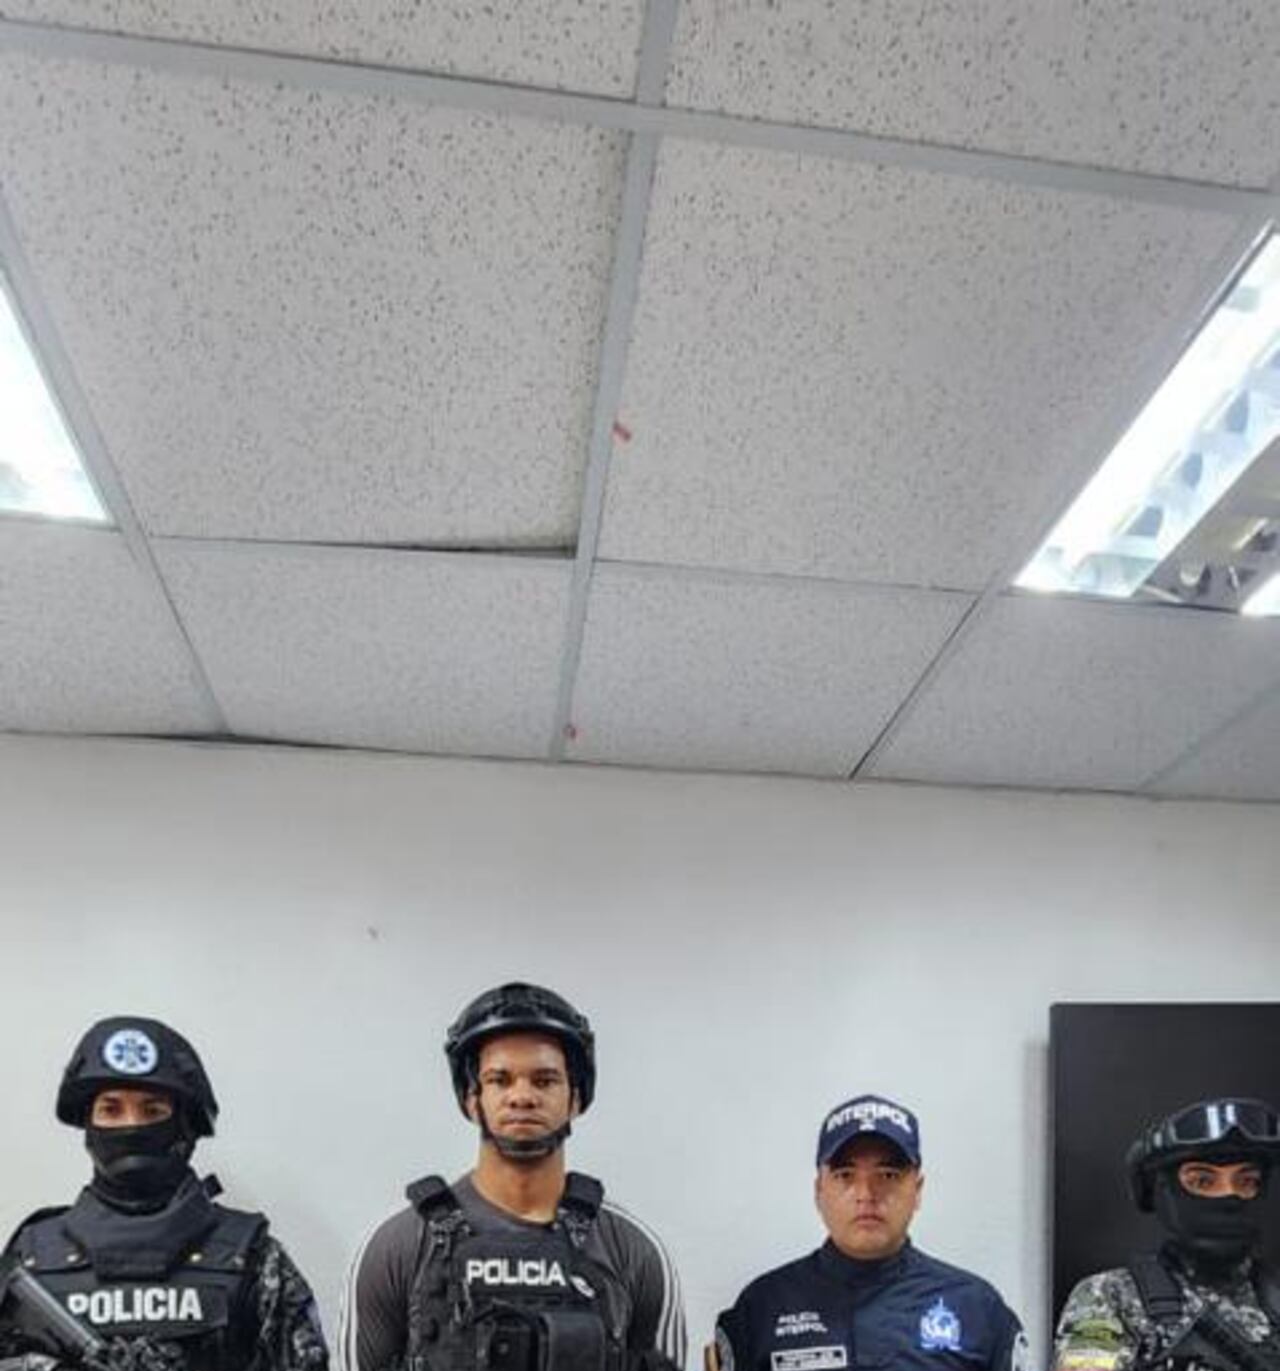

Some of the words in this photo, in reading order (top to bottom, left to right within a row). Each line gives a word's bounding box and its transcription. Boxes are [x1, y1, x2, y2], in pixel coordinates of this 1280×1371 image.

[827, 1102, 912, 1132] INTERPOL
[466, 1258, 567, 1287] POLICIA
[67, 1287, 203, 1324] POLICIA
